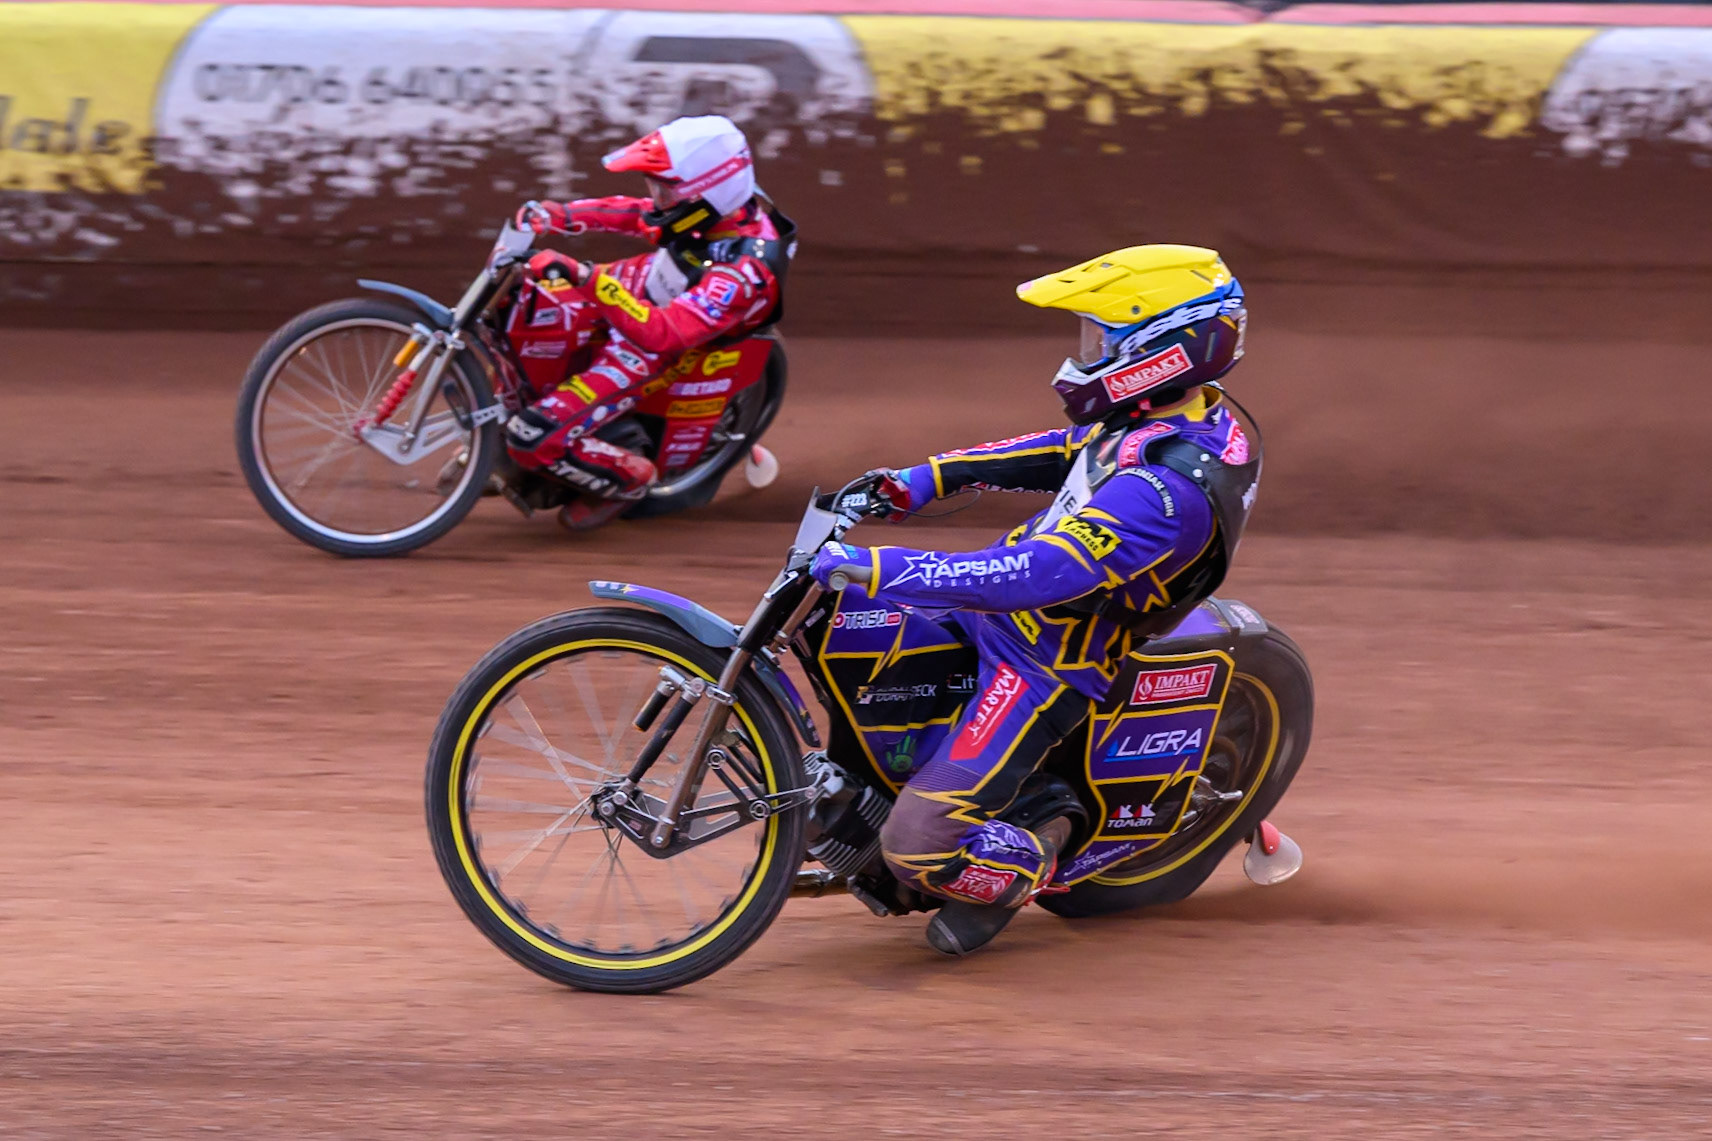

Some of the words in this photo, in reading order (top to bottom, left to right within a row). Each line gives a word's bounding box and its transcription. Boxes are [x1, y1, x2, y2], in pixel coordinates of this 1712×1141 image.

[0, 95, 132, 156] ale
[1121, 352, 1181, 387] IMPAKT
[919, 553, 1031, 579] TAPSAM
[933, 570, 1031, 588] DESIGNS
[1155, 669, 1211, 690] IMPAKT
[1116, 728, 1203, 757] LIGRA
